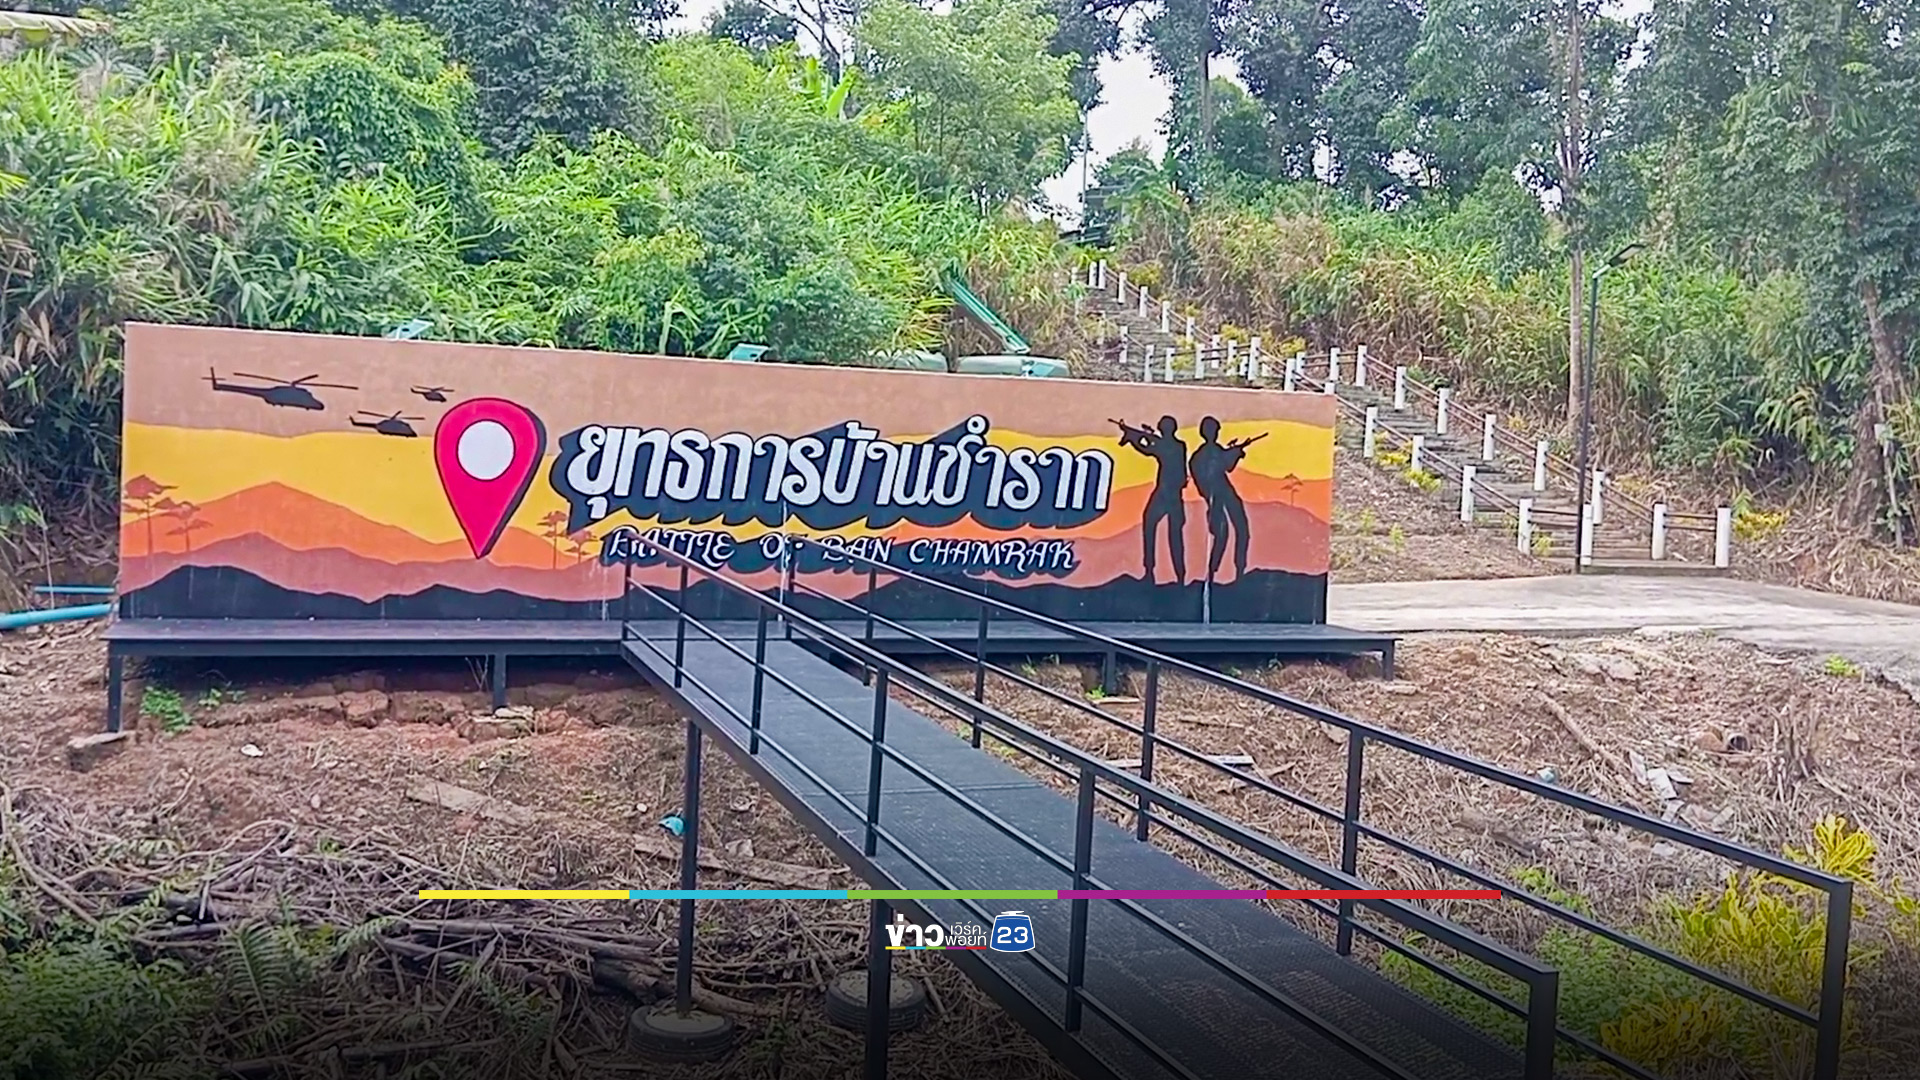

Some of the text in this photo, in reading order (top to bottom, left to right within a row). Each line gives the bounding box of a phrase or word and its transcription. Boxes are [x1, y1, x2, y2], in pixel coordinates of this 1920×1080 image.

[567, 415, 1113, 519] ยุทธการบ้านชำราก
[821, 535, 893, 564] BAN
[909, 539, 1074, 572] CHAMRAK
